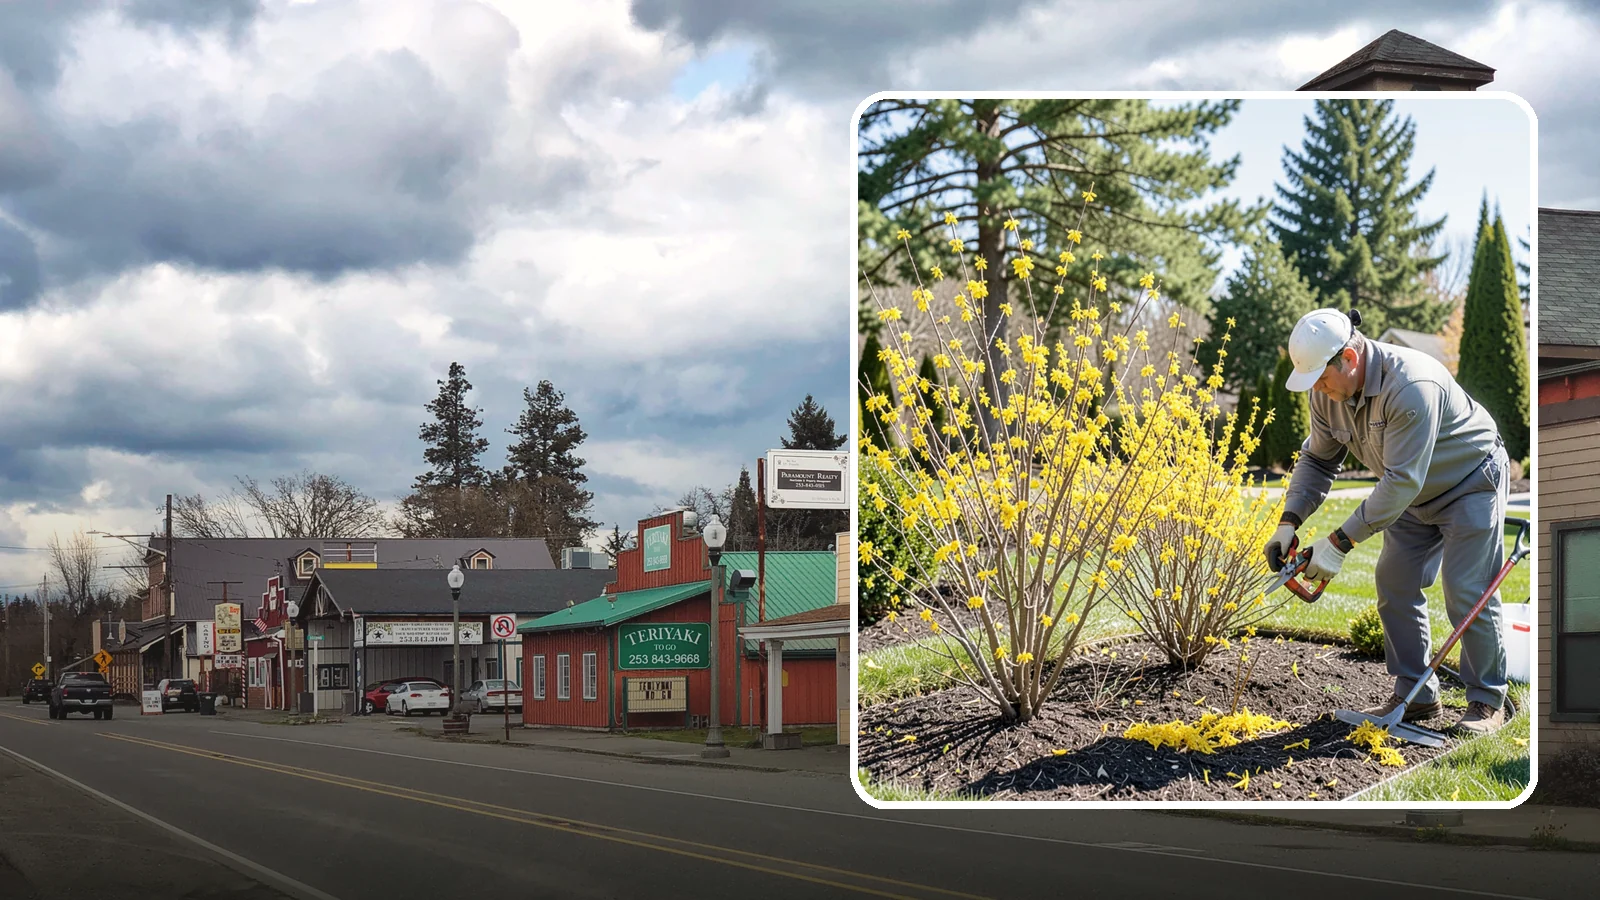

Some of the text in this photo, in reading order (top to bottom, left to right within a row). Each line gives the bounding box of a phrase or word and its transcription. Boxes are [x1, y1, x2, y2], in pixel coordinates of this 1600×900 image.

[625, 627, 702, 646] TERIYAKI
[629, 654, 700, 665] 253 843-9668
